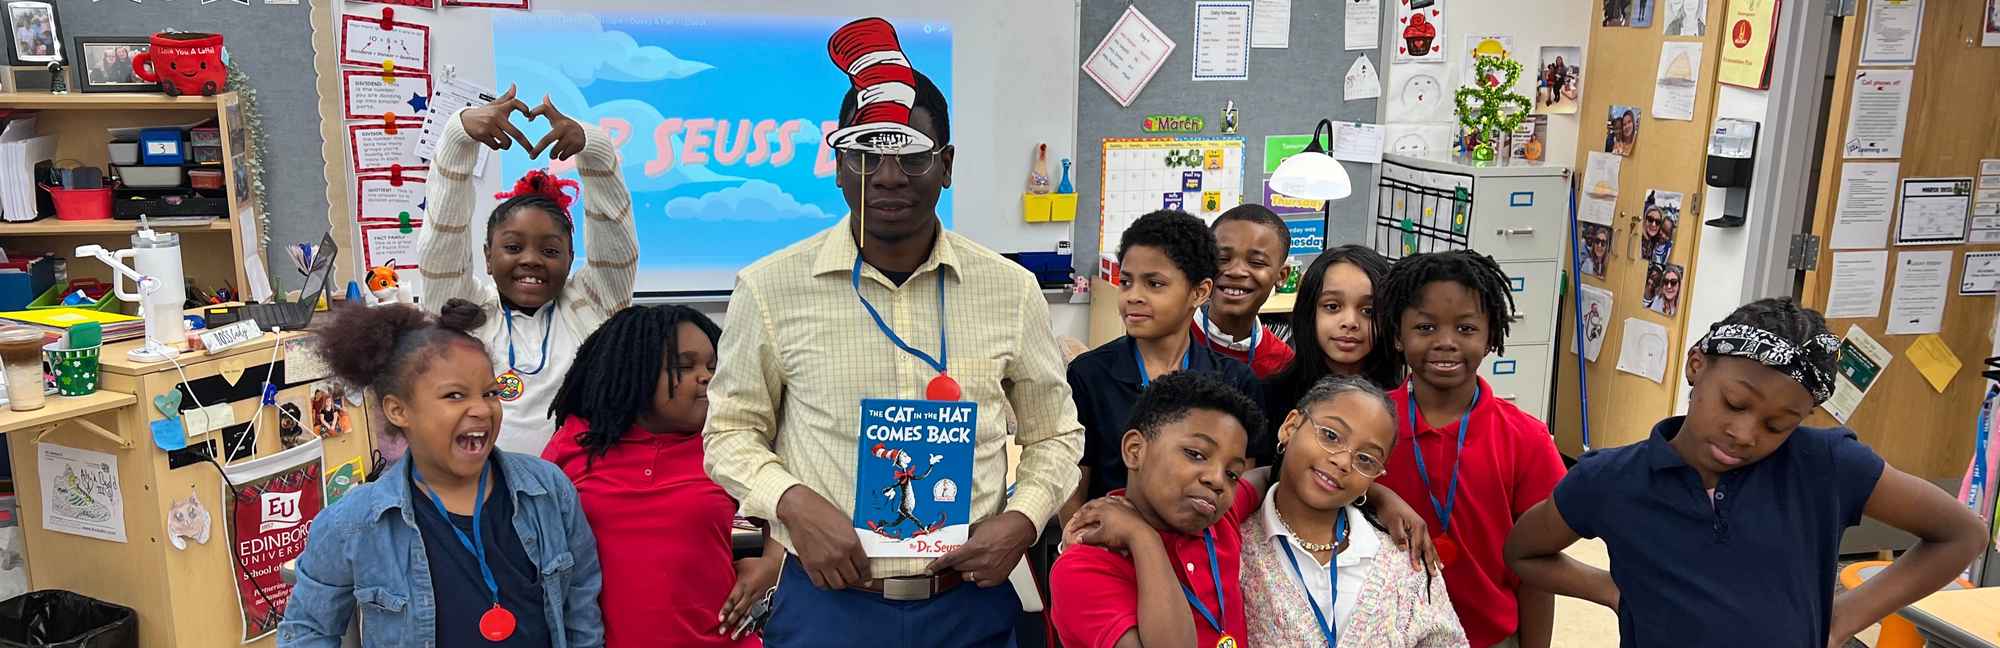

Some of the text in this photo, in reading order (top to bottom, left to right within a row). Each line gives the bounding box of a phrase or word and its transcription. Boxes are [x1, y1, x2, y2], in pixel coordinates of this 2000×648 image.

[176, 47, 188, 56] You
[190, 47, 196, 55] A
[1158, 117, 1199, 131] March
[158, 142, 167, 154] 3
[645, 119, 801, 177] SEUSS
[884, 406, 914, 423] CAT
[938, 407, 971, 422] HAT
[866, 425, 971, 444] COMES BACK
[268, 497, 295, 517] EU
[917, 541, 933, 552] Dr.
[243, 564, 272, 580] School
